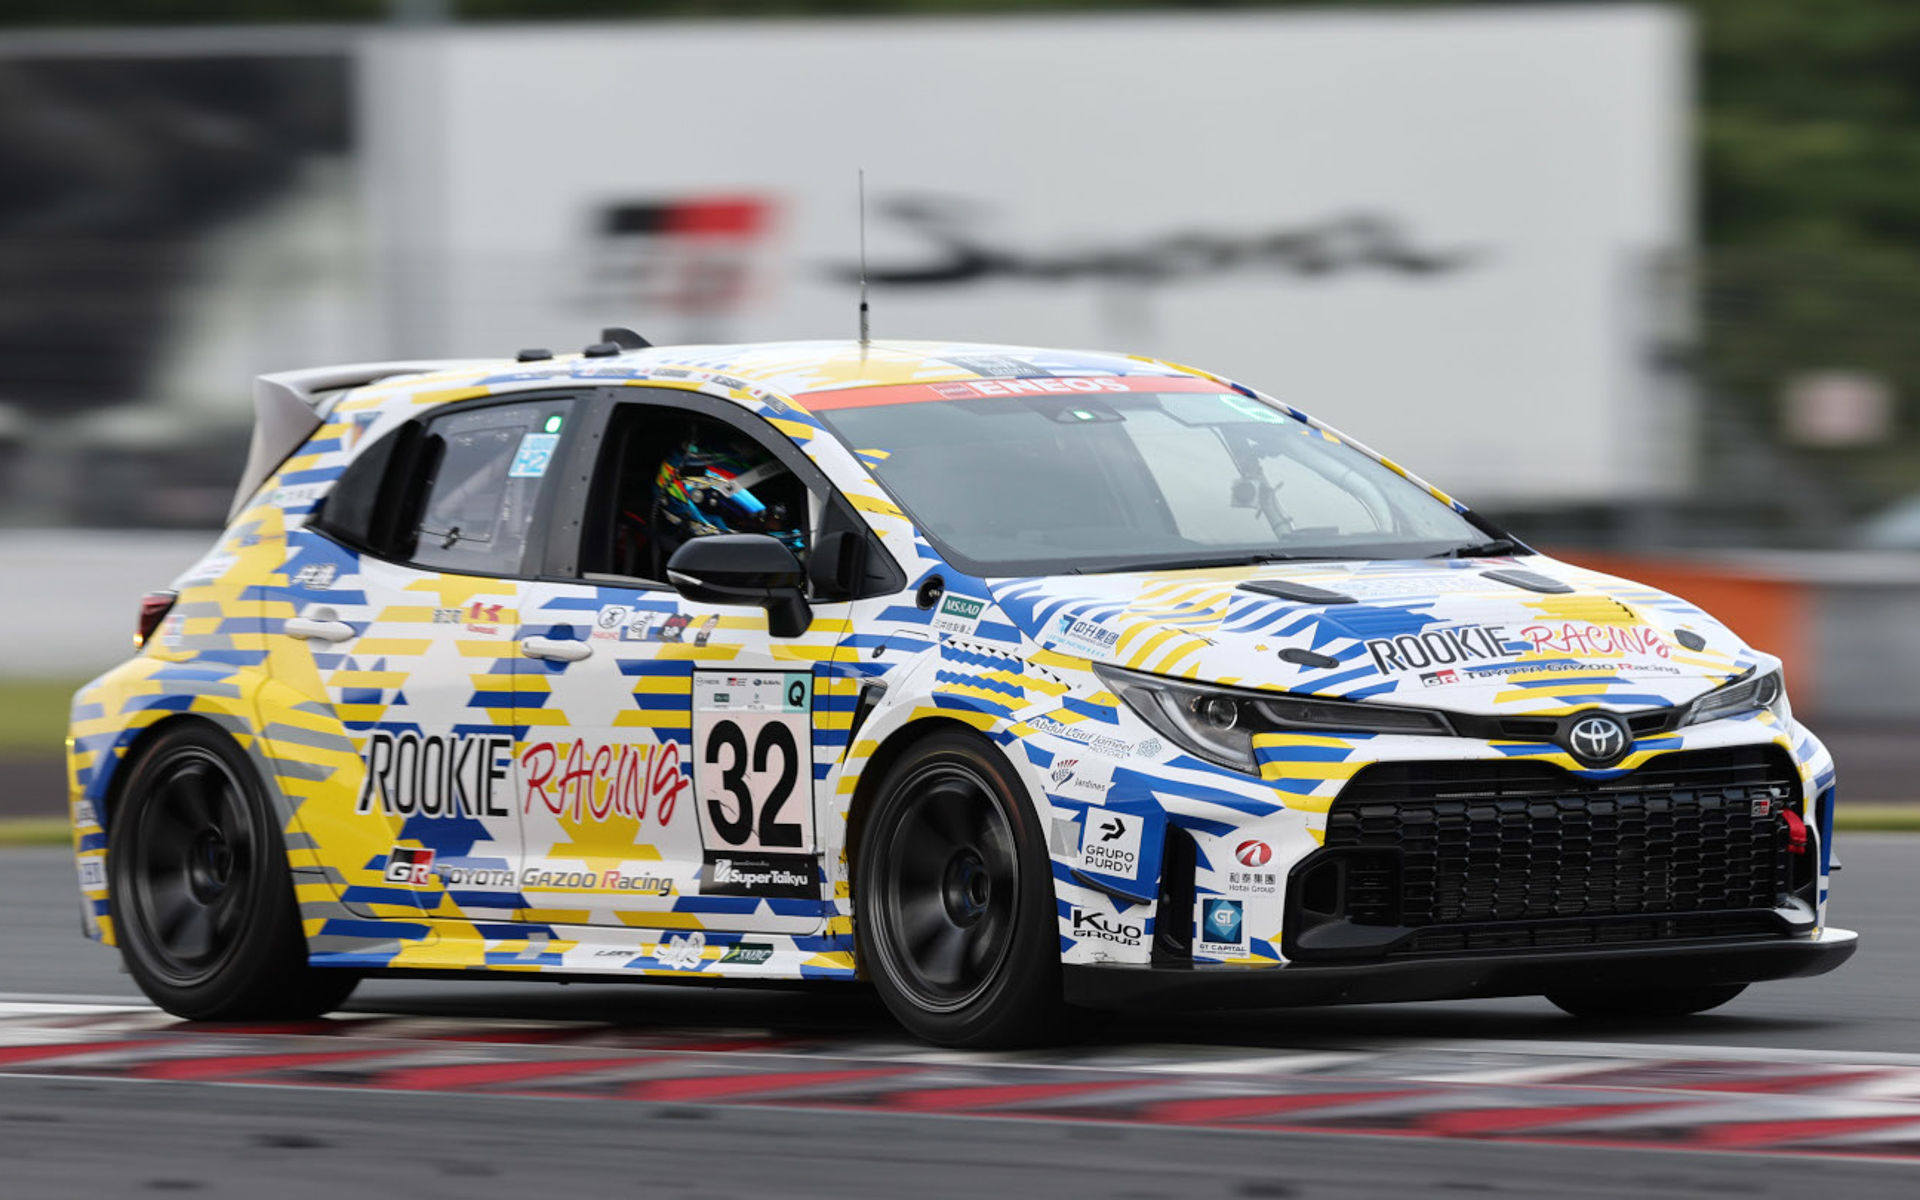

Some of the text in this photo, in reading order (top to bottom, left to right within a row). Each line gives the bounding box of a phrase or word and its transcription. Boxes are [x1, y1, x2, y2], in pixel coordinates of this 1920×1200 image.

[966, 378, 1131, 395] ENEOS
[944, 599, 980, 616] MS&AD
[1367, 623, 1672, 676] ROOKIE RACING
[1463, 662, 1681, 680] TOYOTA GAZOO Racing
[1423, 673, 1459, 687] GR
[788, 680, 805, 708] Q
[1030, 718, 1135, 752] Abdul Latif Jameel
[358, 734, 689, 827] ROOKIE RACING
[705, 719, 803, 848] 32
[1085, 844, 1135, 863] GRUPO
[385, 861, 430, 885] GR
[1085, 856, 1133, 873] PURDY
[436, 863, 674, 897] TOYOTA GAZOO Racing
[1229, 872, 1276, 885] 和泰集團
[1229, 884, 1276, 893] Hotai Group
[1214, 909, 1236, 924] GT
[1073, 930, 1141, 946] GROUP
[736, 949, 772, 961] SMBC
[1211, 944, 1247, 952] CAPITAL
